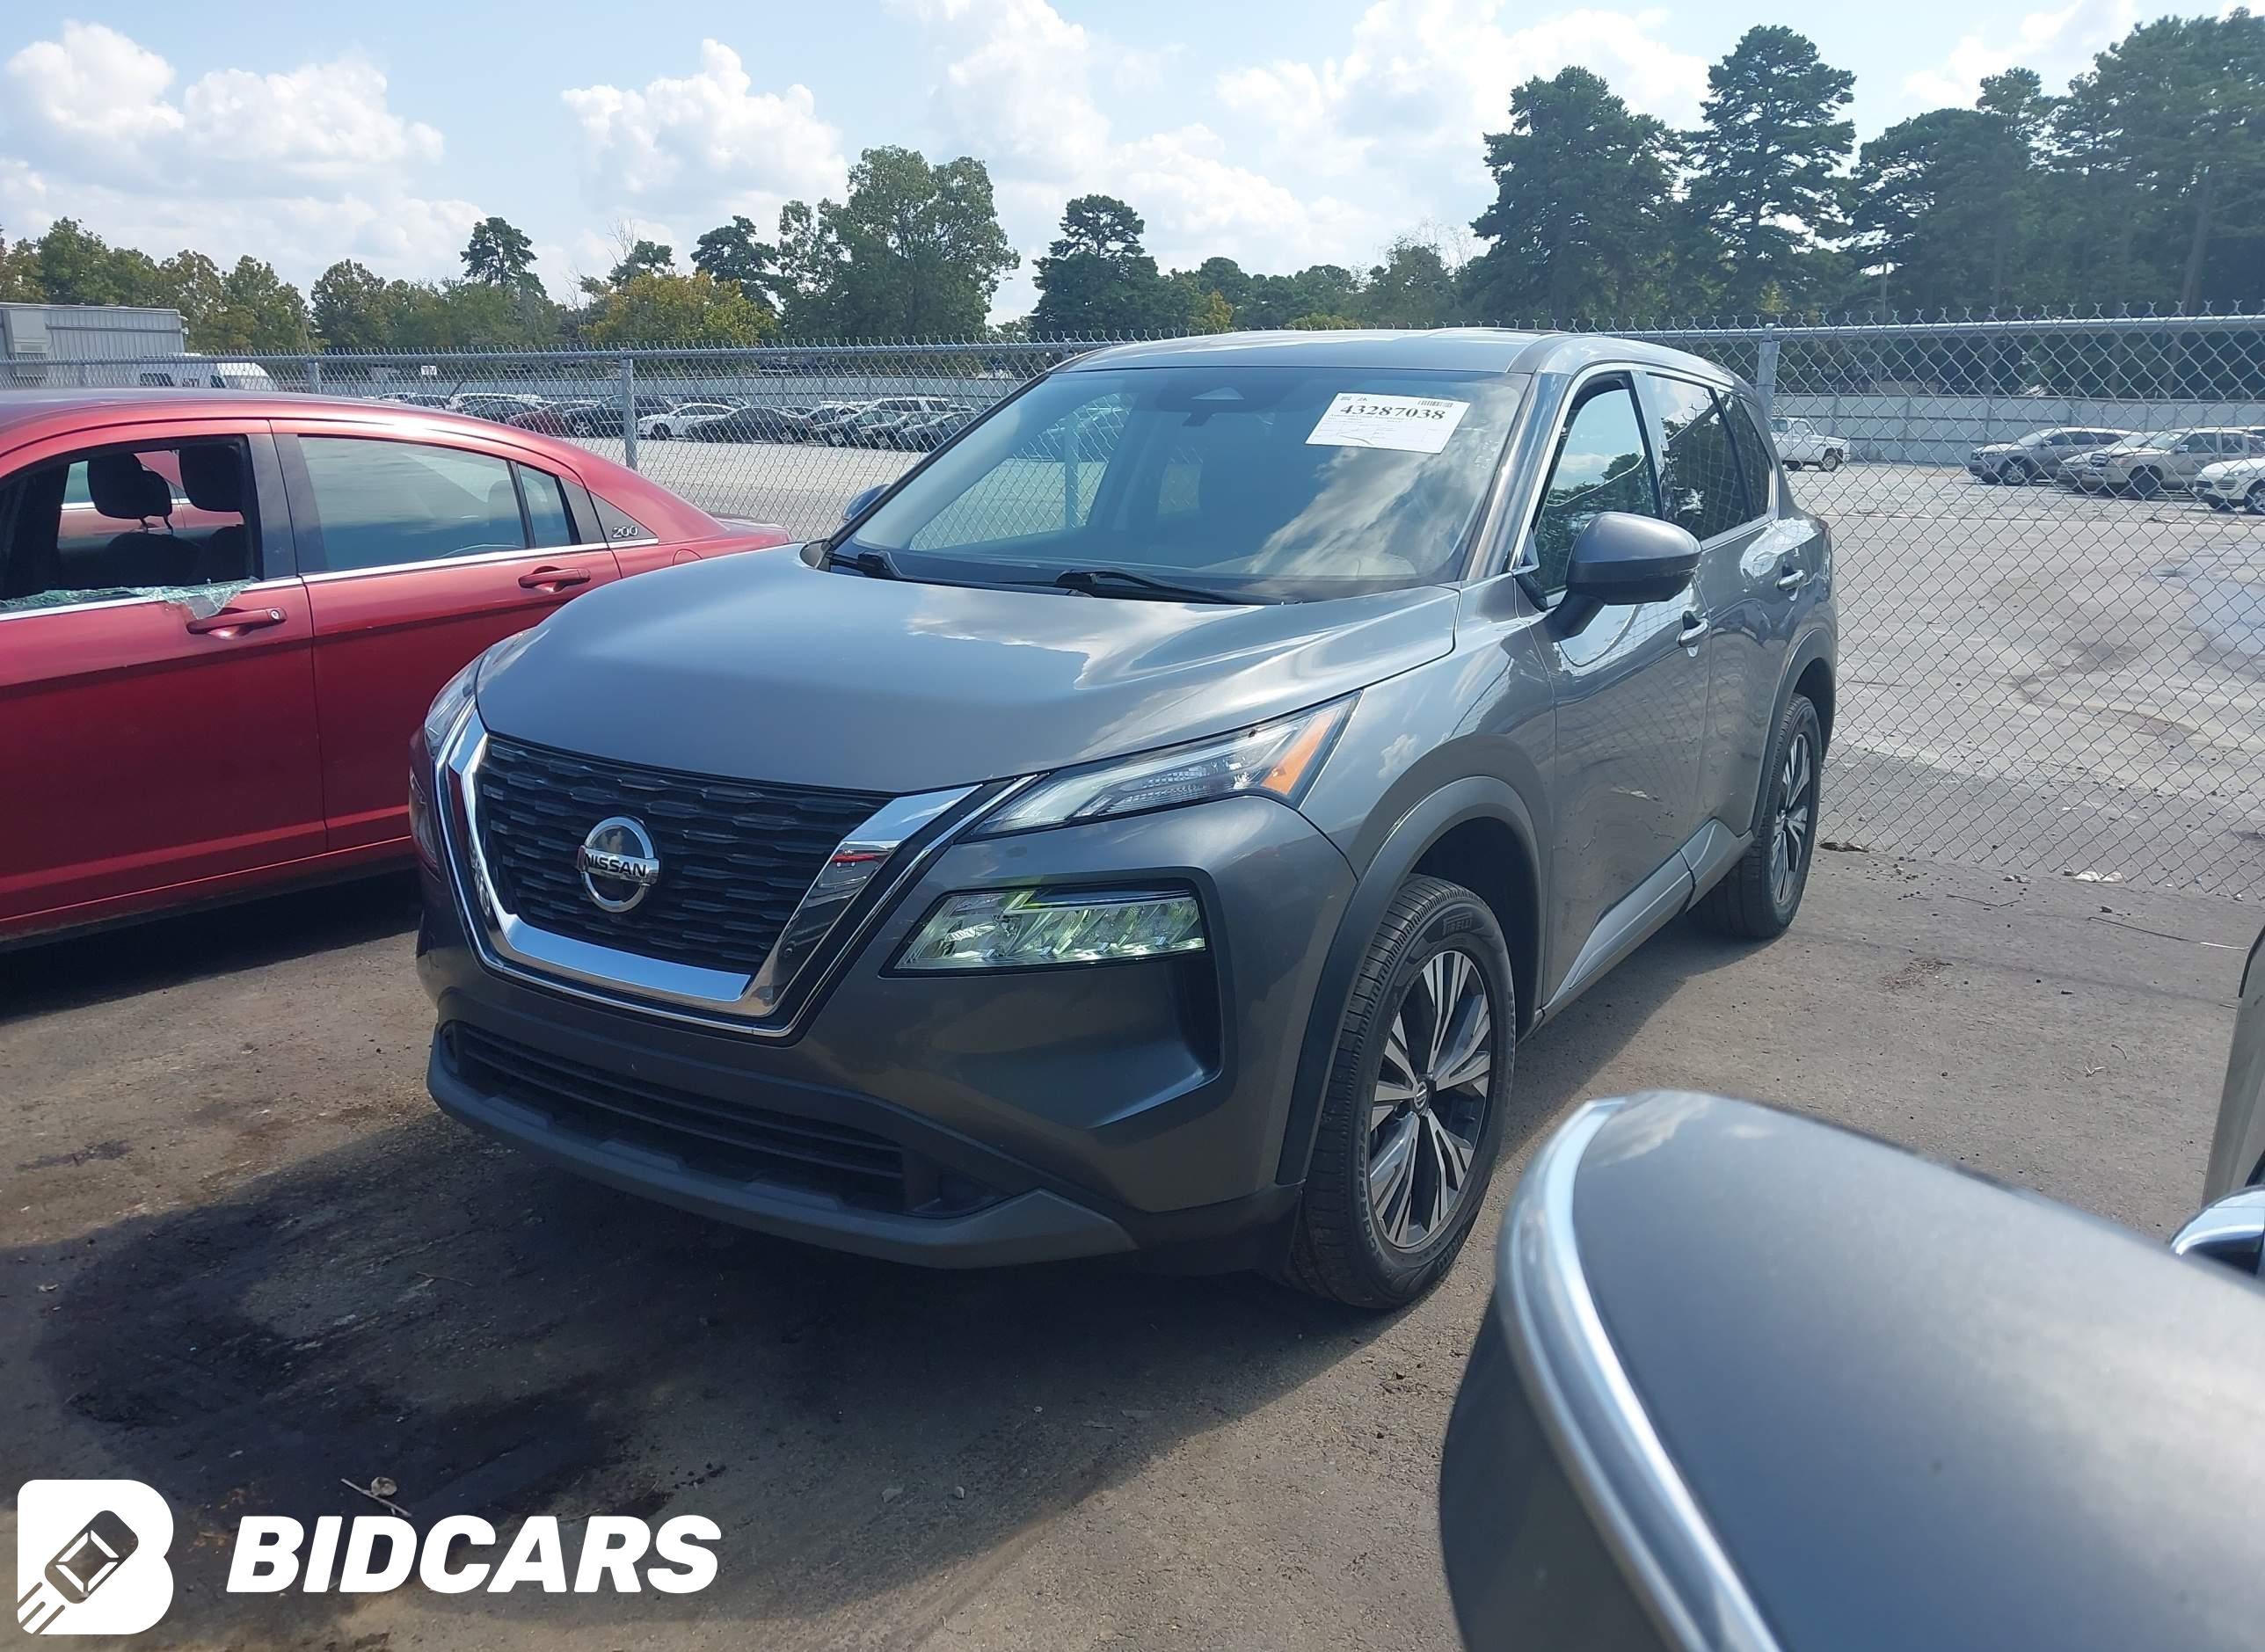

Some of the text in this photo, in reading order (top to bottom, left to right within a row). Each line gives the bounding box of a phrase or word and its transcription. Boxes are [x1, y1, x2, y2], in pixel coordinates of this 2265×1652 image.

[1340, 404, 1446, 420] 43287038
[612, 525, 638, 538] 200
[584, 853, 647, 877] NISSAN
